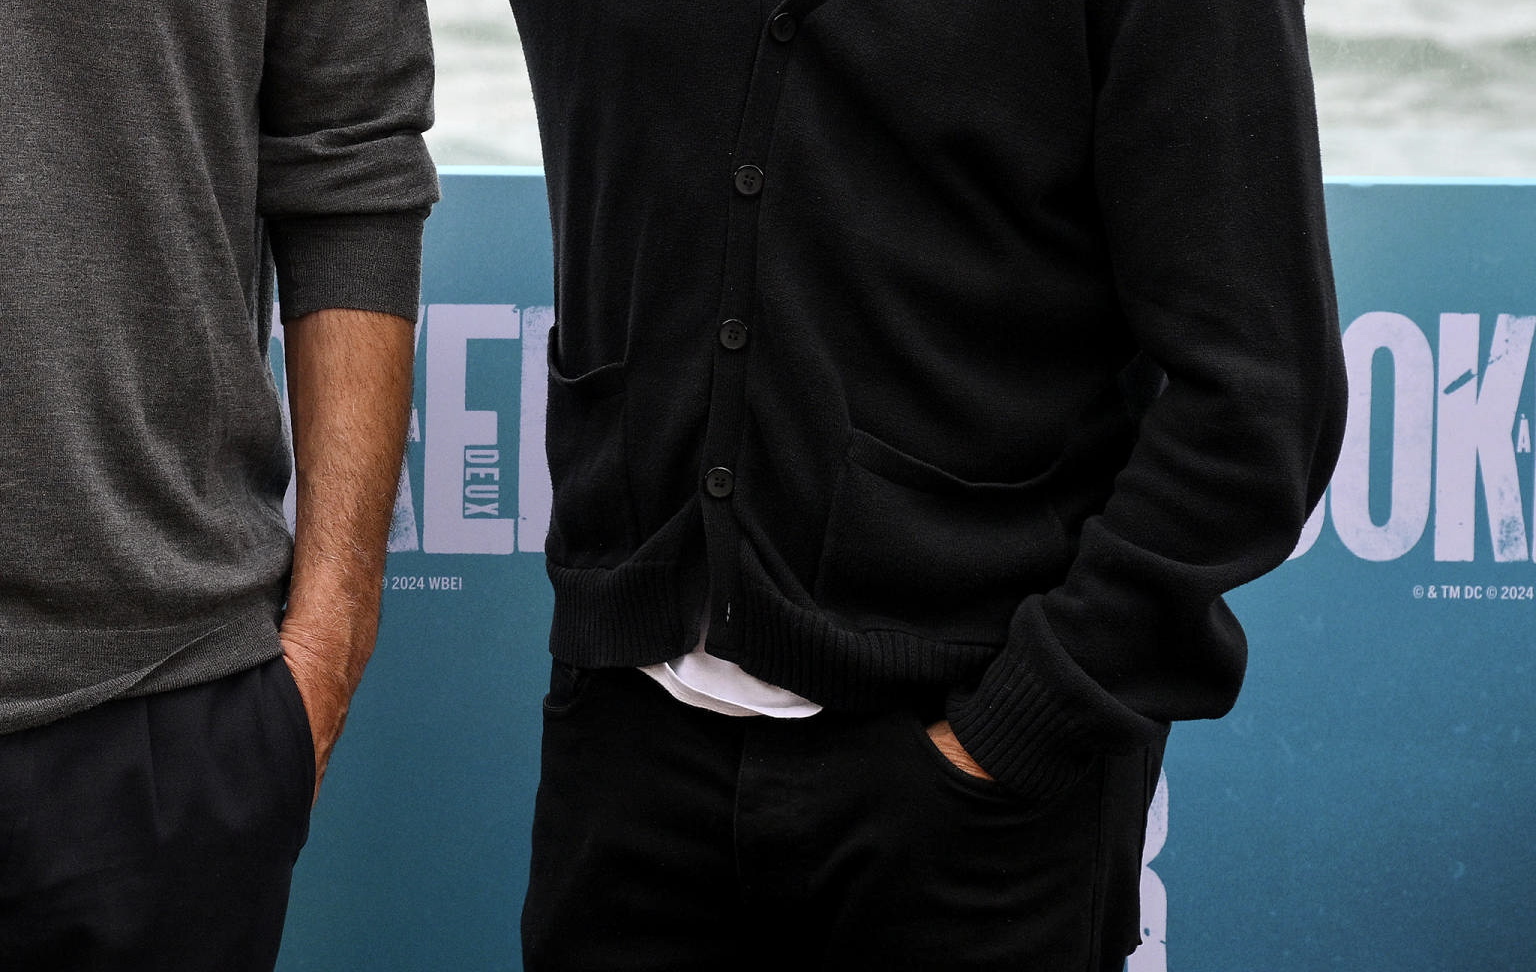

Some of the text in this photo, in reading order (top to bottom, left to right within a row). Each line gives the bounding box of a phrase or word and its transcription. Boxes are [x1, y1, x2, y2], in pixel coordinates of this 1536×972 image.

[1286, 311, 1536, 563] OK
[464, 449, 499, 516] DEUX
[392, 576, 424, 589] 2024
[429, 577, 462, 590] WBEI
[1427, 585, 1437, 599] &
[1441, 586, 1460, 599] TM
[1465, 586, 1482, 599] DC
[1501, 586, 1534, 599] 2024
